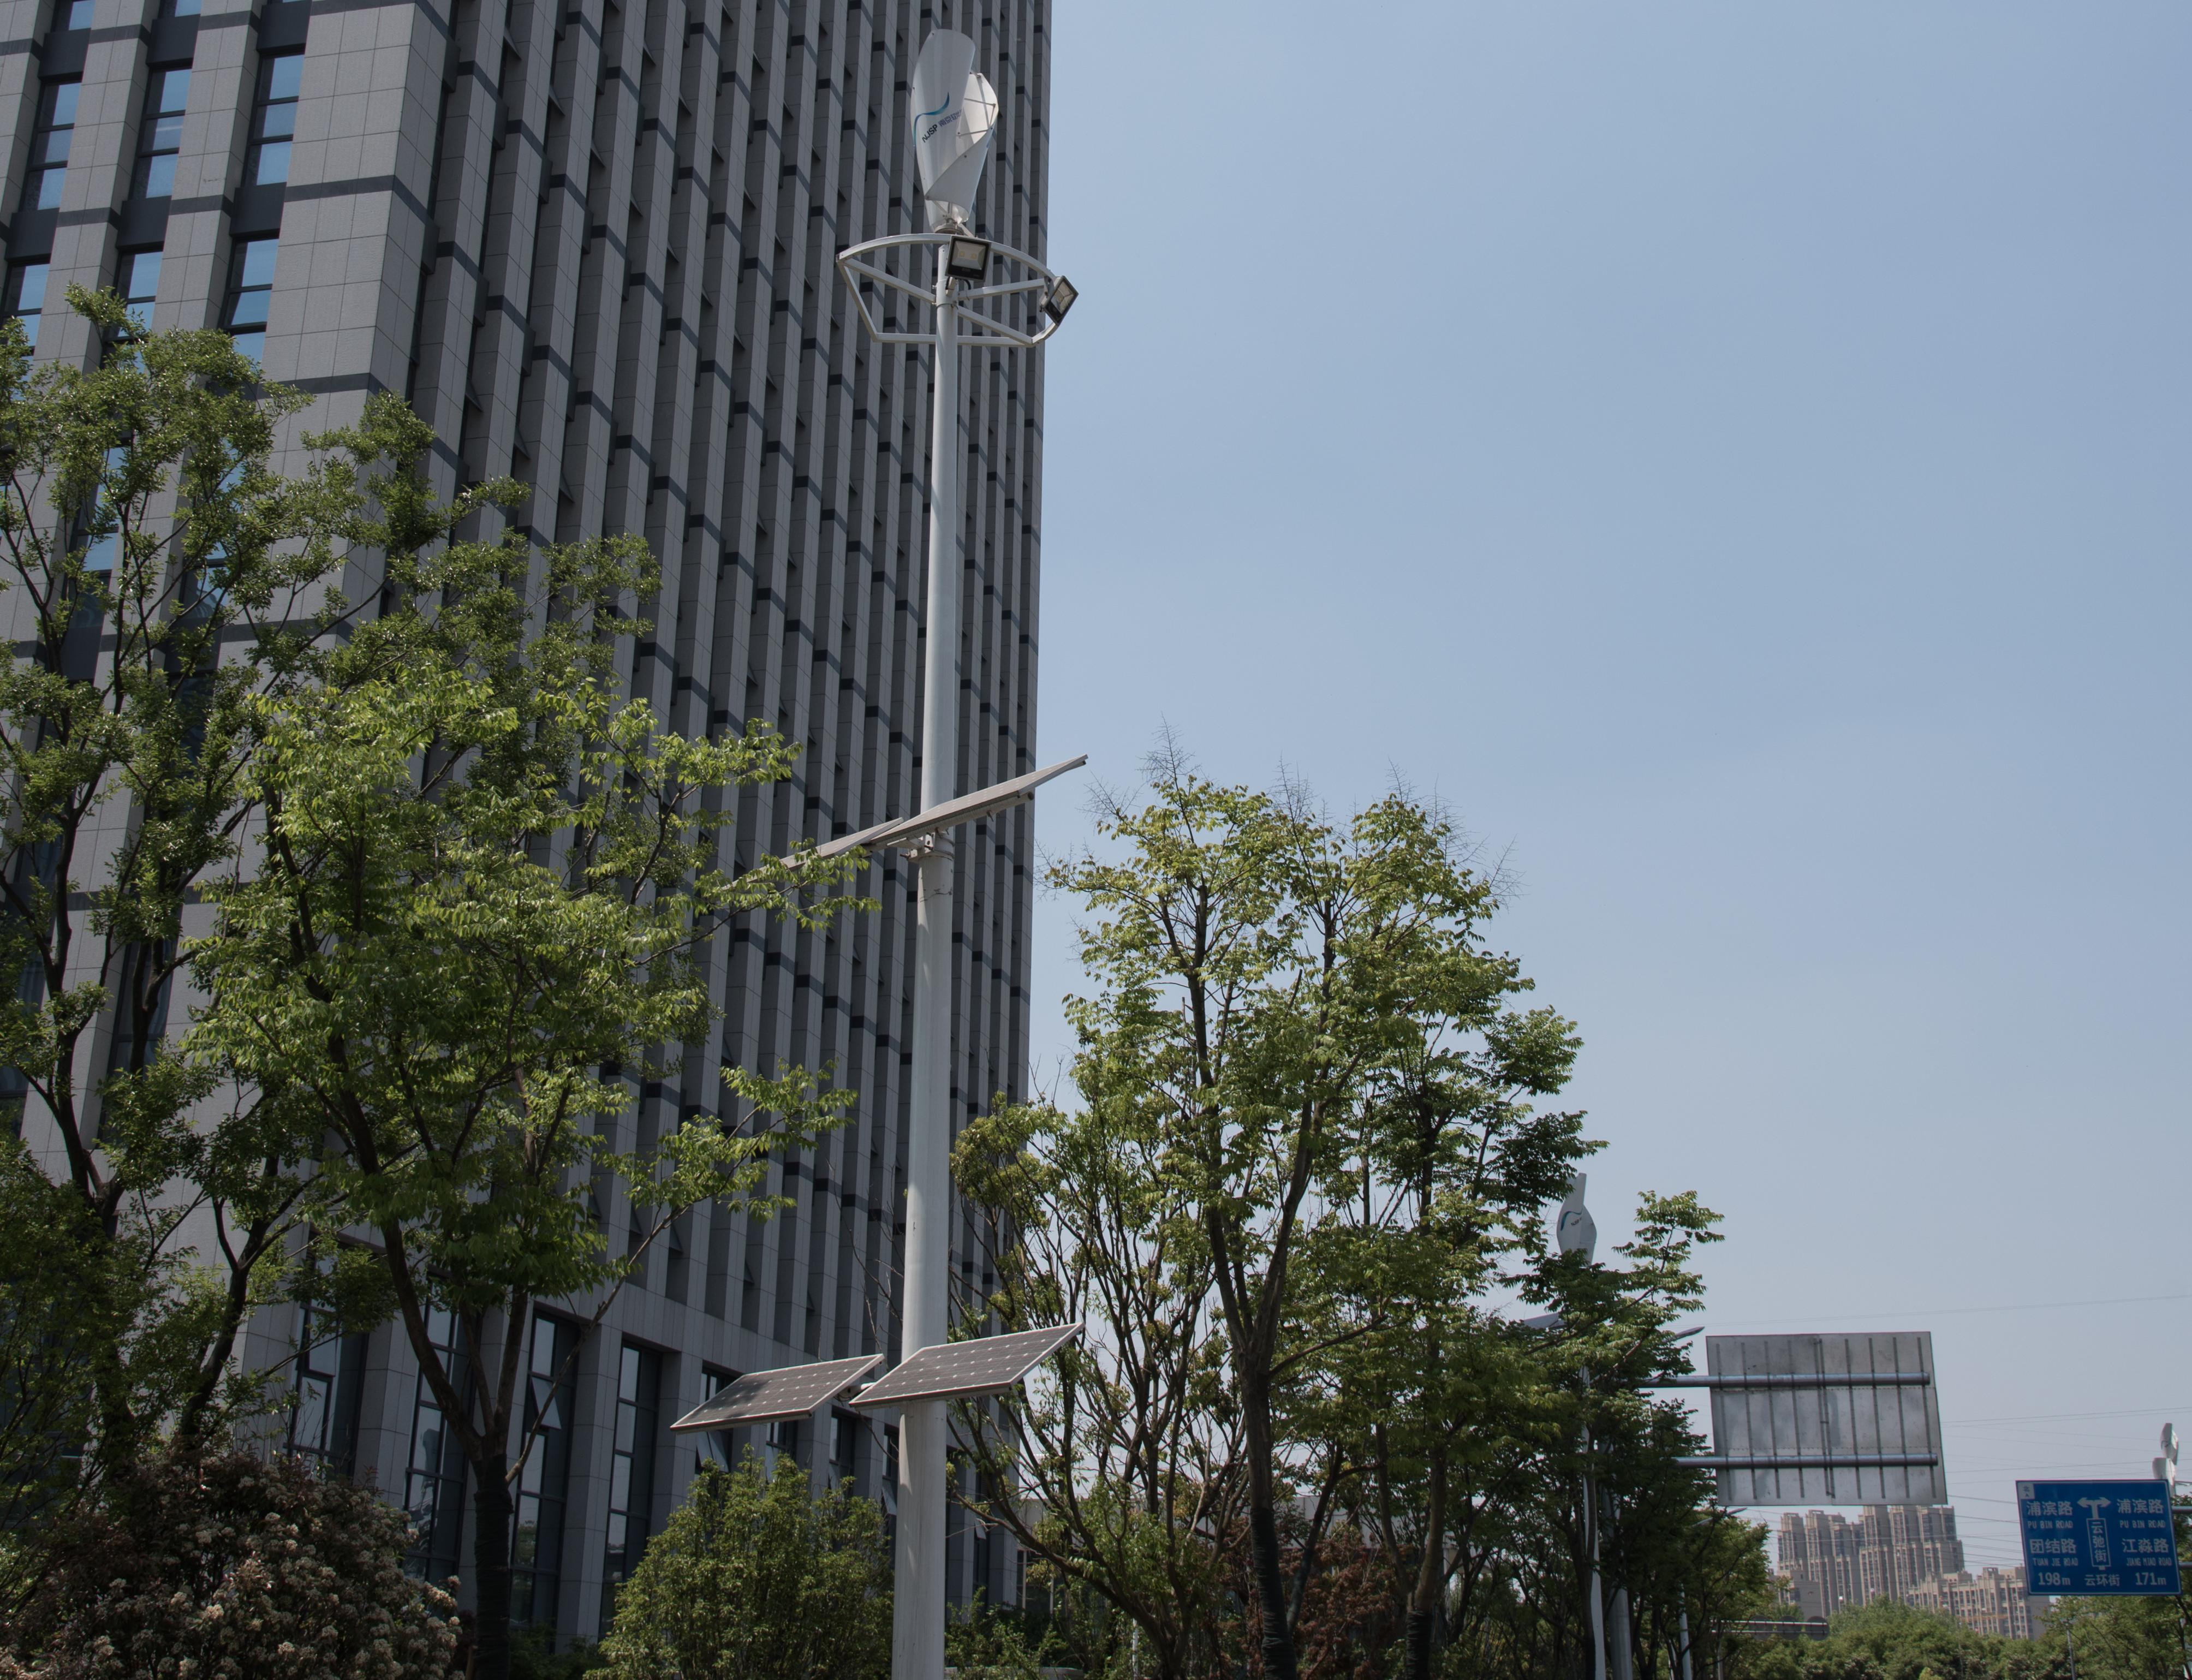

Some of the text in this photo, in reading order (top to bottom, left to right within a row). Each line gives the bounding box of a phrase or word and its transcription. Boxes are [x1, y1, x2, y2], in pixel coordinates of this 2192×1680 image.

[922, 124, 938, 143] NJSP
[2026, 1500, 2074, 1516] 浦滨路
[2117, 1499, 2164, 1514] 浦滨路
[2056, 1520, 2074, 1528] ROAD
[2119, 1520, 2166, 1528] PU BIN ROAD
[2029, 1538, 2076, 1554] 团结路
[2092, 1522, 2106, 1563] 云弛街
[2122, 1538, 2169, 1553] 江淼路
[2033, 1558, 2078, 1566] TUAN JIE ROAD
[2127, 1557, 2172, 1566] JIANG MIAO ROAD
[2038, 1572, 2071, 1586] 198m
[2084, 1574, 2120, 1587] 云环街
[2135, 1572, 2167, 1586] 171m
